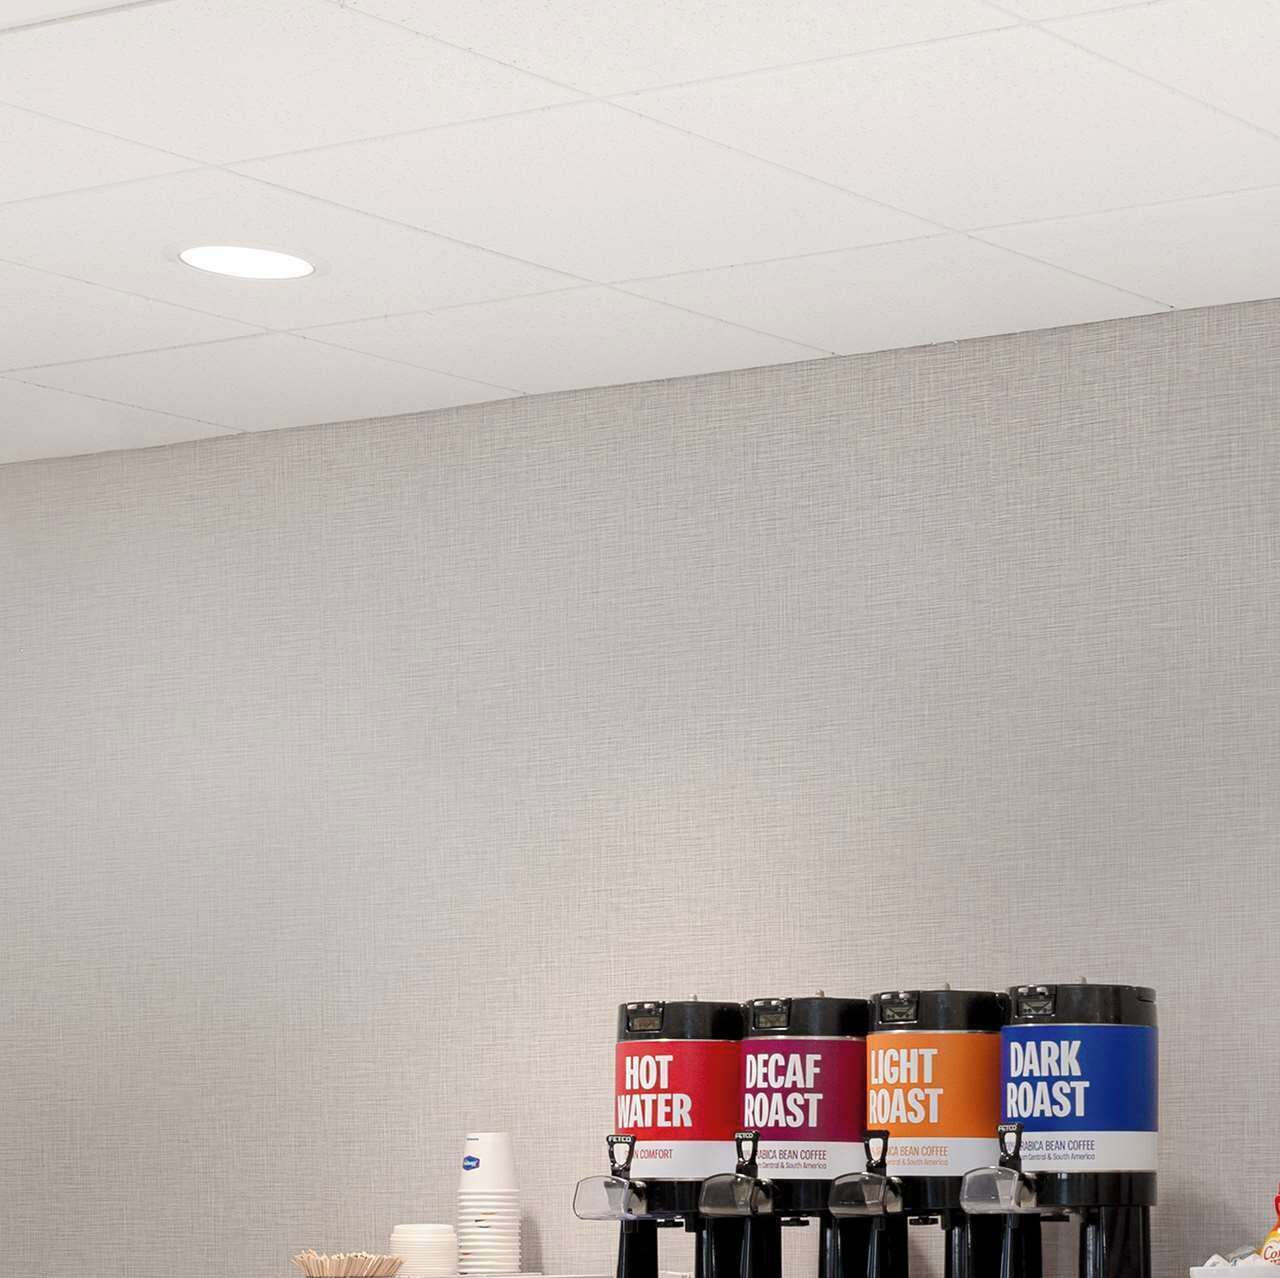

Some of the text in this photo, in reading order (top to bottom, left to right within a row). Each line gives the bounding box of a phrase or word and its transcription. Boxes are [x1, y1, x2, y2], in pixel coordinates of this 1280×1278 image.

[625, 1054, 674, 1090] HOT
[745, 1053, 822, 1090] DECAF
[871, 1048, 938, 1085] LIGHT
[1010, 1040, 1082, 1077] DARK
[617, 1093, 693, 1129] WATER
[744, 1092, 824, 1128] ROAST
[869, 1087, 944, 1124] ROAST
[1006, 1081, 1090, 1118] ROAST
[639, 1148, 673, 1160] COMFORT
[778, 1149, 799, 1161] BEAN
[799, 1149, 827, 1161] COFFEE
[899, 1145, 948, 1157] BEAN COFFEE
[1045, 1139, 1066, 1151] BEAN
[1067, 1139, 1095, 1151] COFFEE
